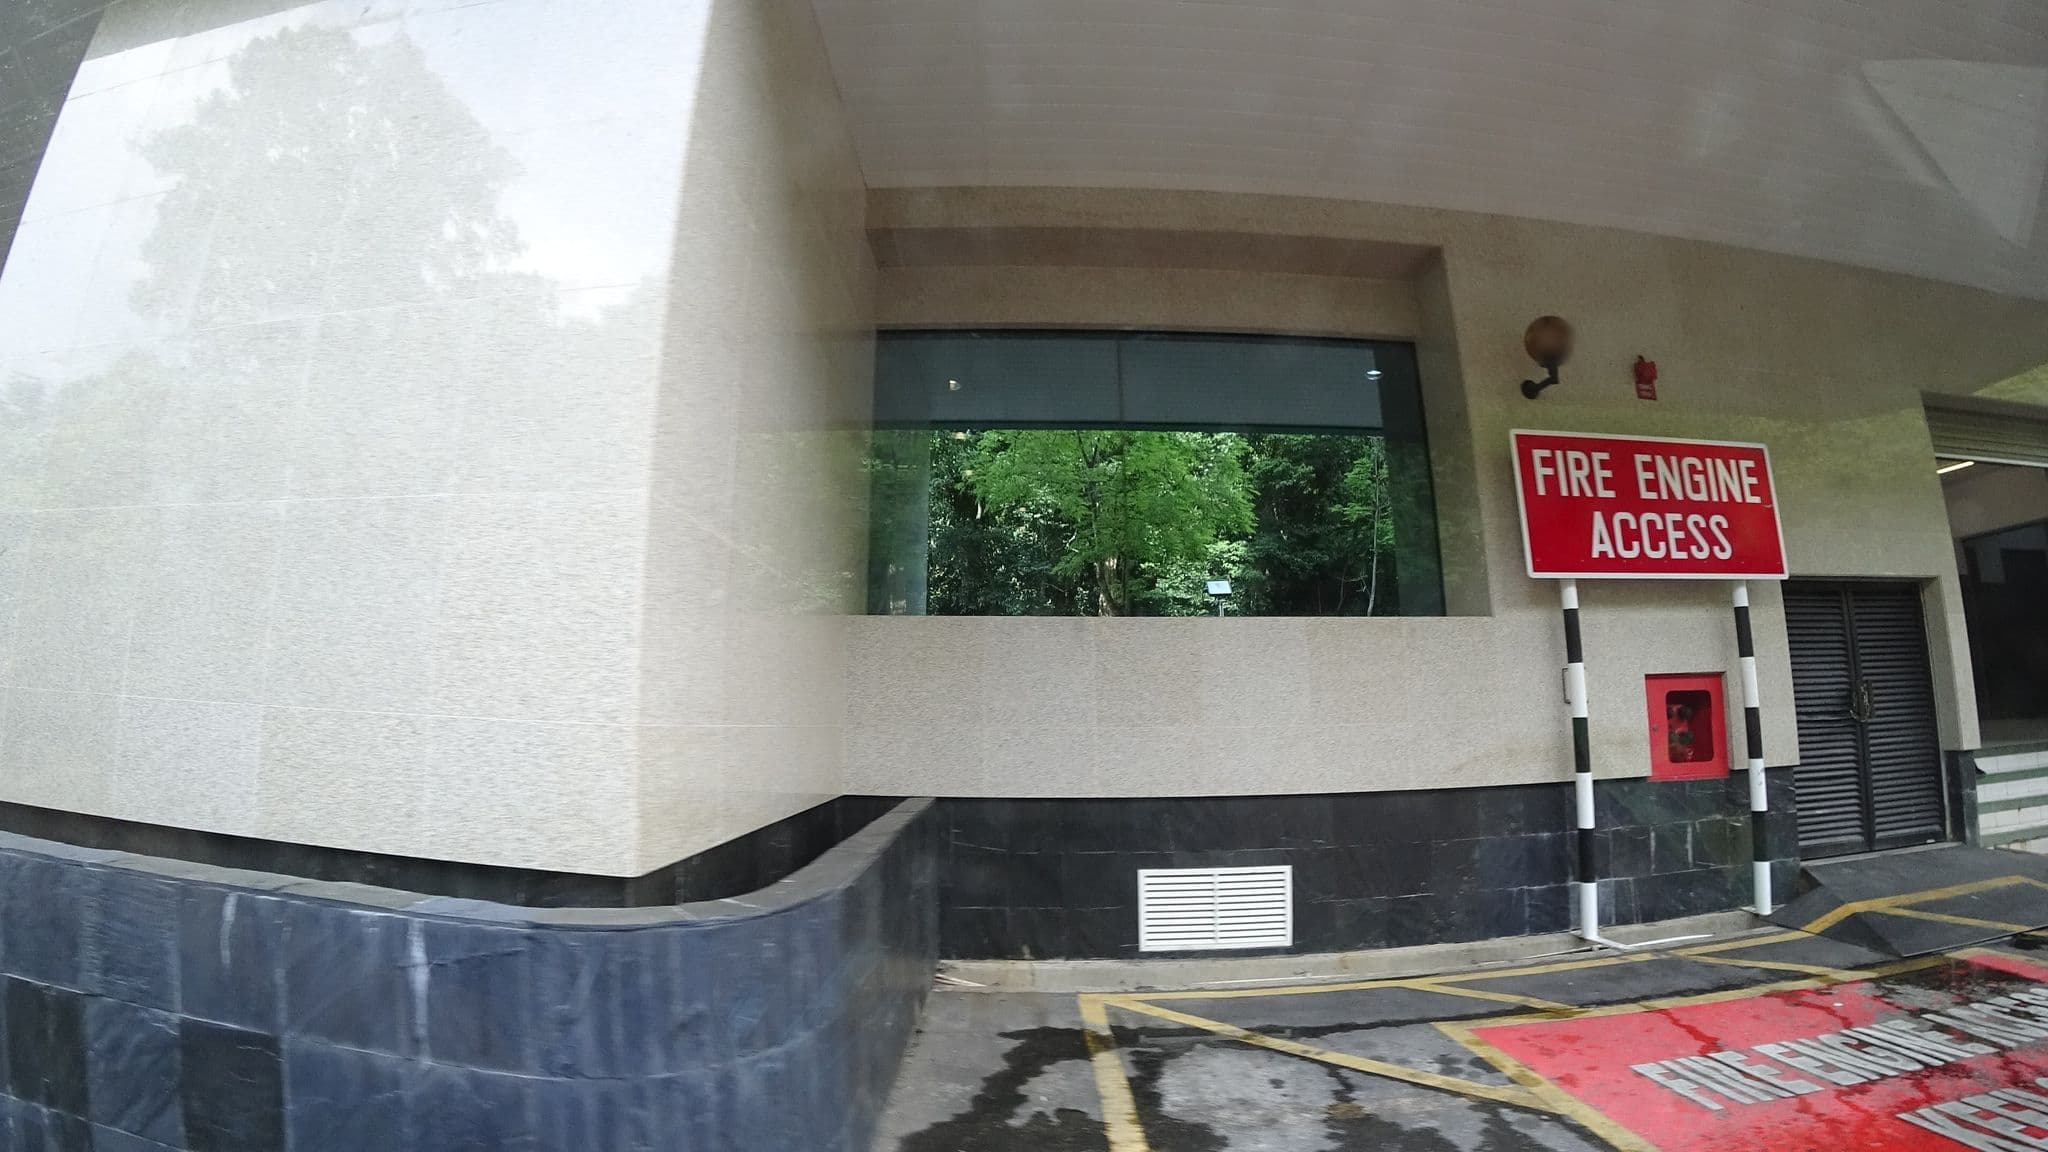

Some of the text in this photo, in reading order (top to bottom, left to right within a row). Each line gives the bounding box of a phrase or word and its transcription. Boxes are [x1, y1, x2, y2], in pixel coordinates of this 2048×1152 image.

[1532, 449, 1761, 504] FIRE ENGINE
[1591, 511, 1732, 560] ACCESS
[1630, 988, 2048, 1110] FIRE ENGINE ACCE
